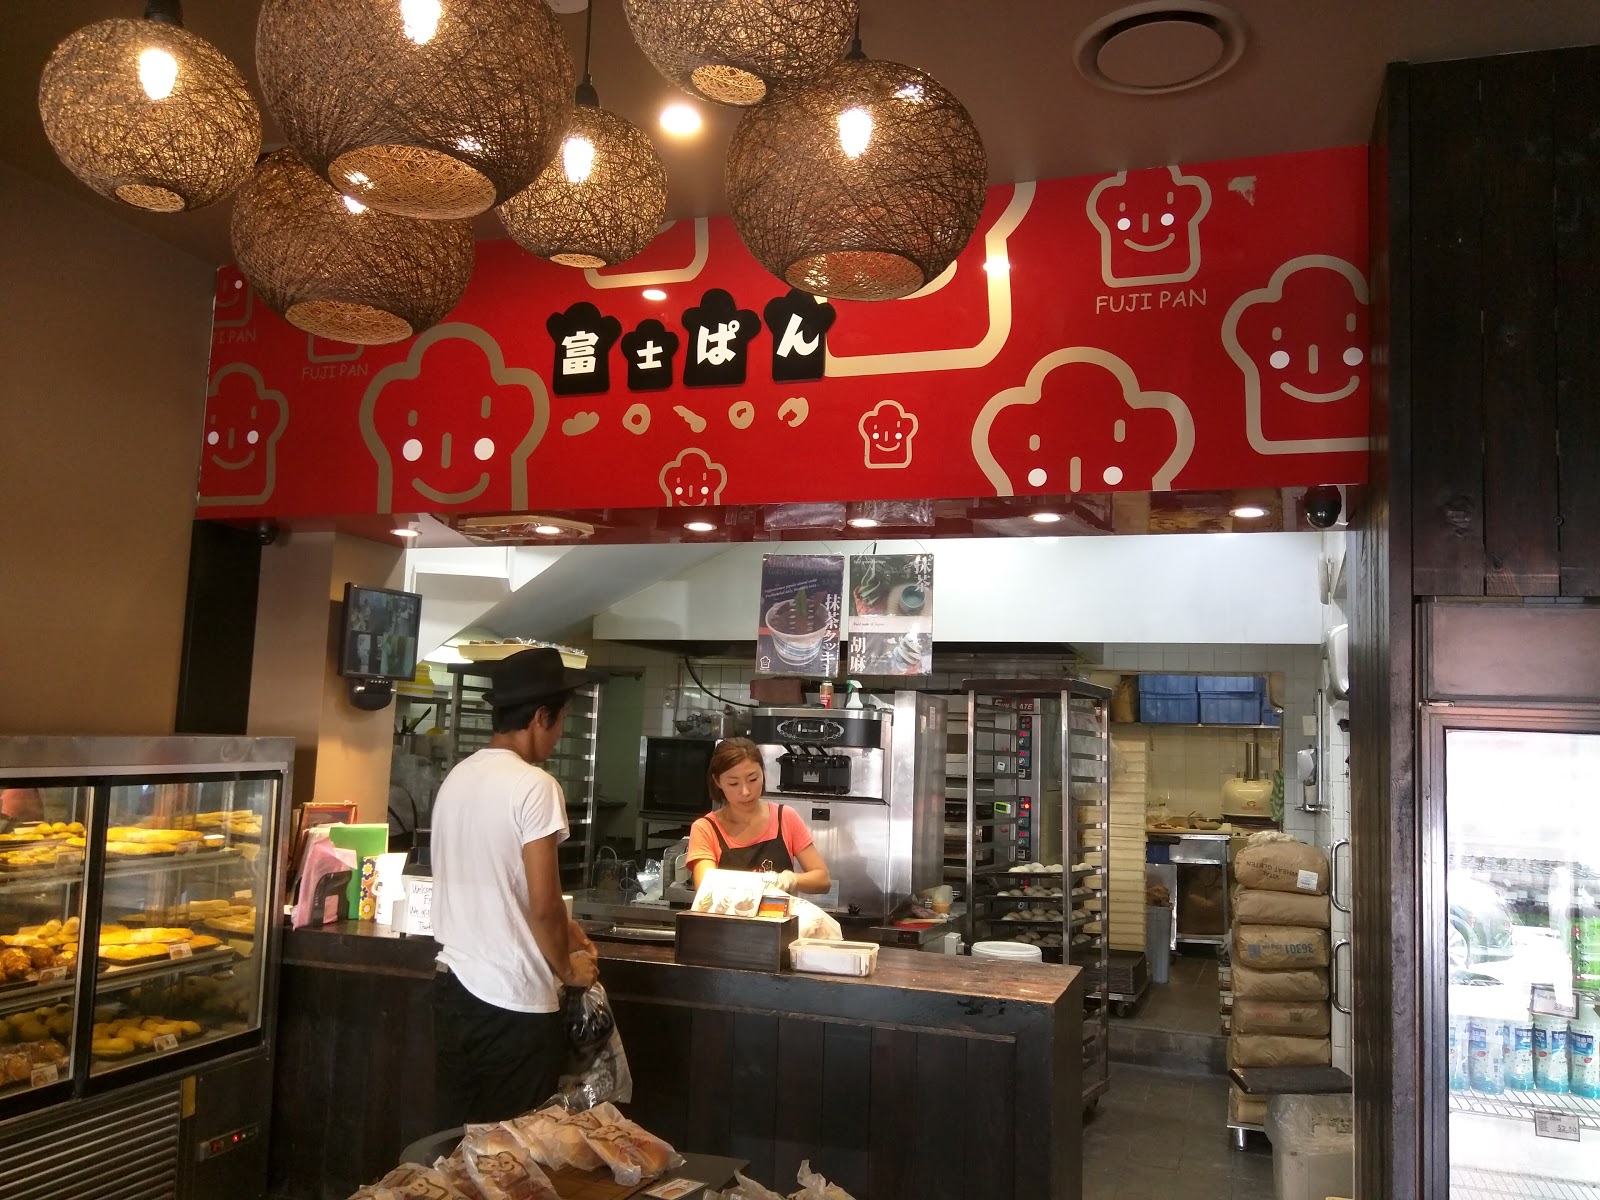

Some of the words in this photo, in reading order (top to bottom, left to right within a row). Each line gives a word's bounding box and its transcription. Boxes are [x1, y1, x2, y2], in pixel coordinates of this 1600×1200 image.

[1096, 292, 1152, 315] FUJI
[1159, 288, 1207, 309] PAN
[229, 328, 256, 343] PAN
[561, 313, 820, 376] 富士ぱん
[302, 366, 336, 380] FUJI
[339, 363, 368, 377] PAN
[913, 554, 933, 593] 抹茶
[850, 636, 867, 672] 胡麻
[1246, 860, 1273, 871] GLUTEN
[1274, 866, 1298, 877] WHEAT
[1262, 870, 1280, 881] VITAL
[1285, 943, 1313, 954] 36301
